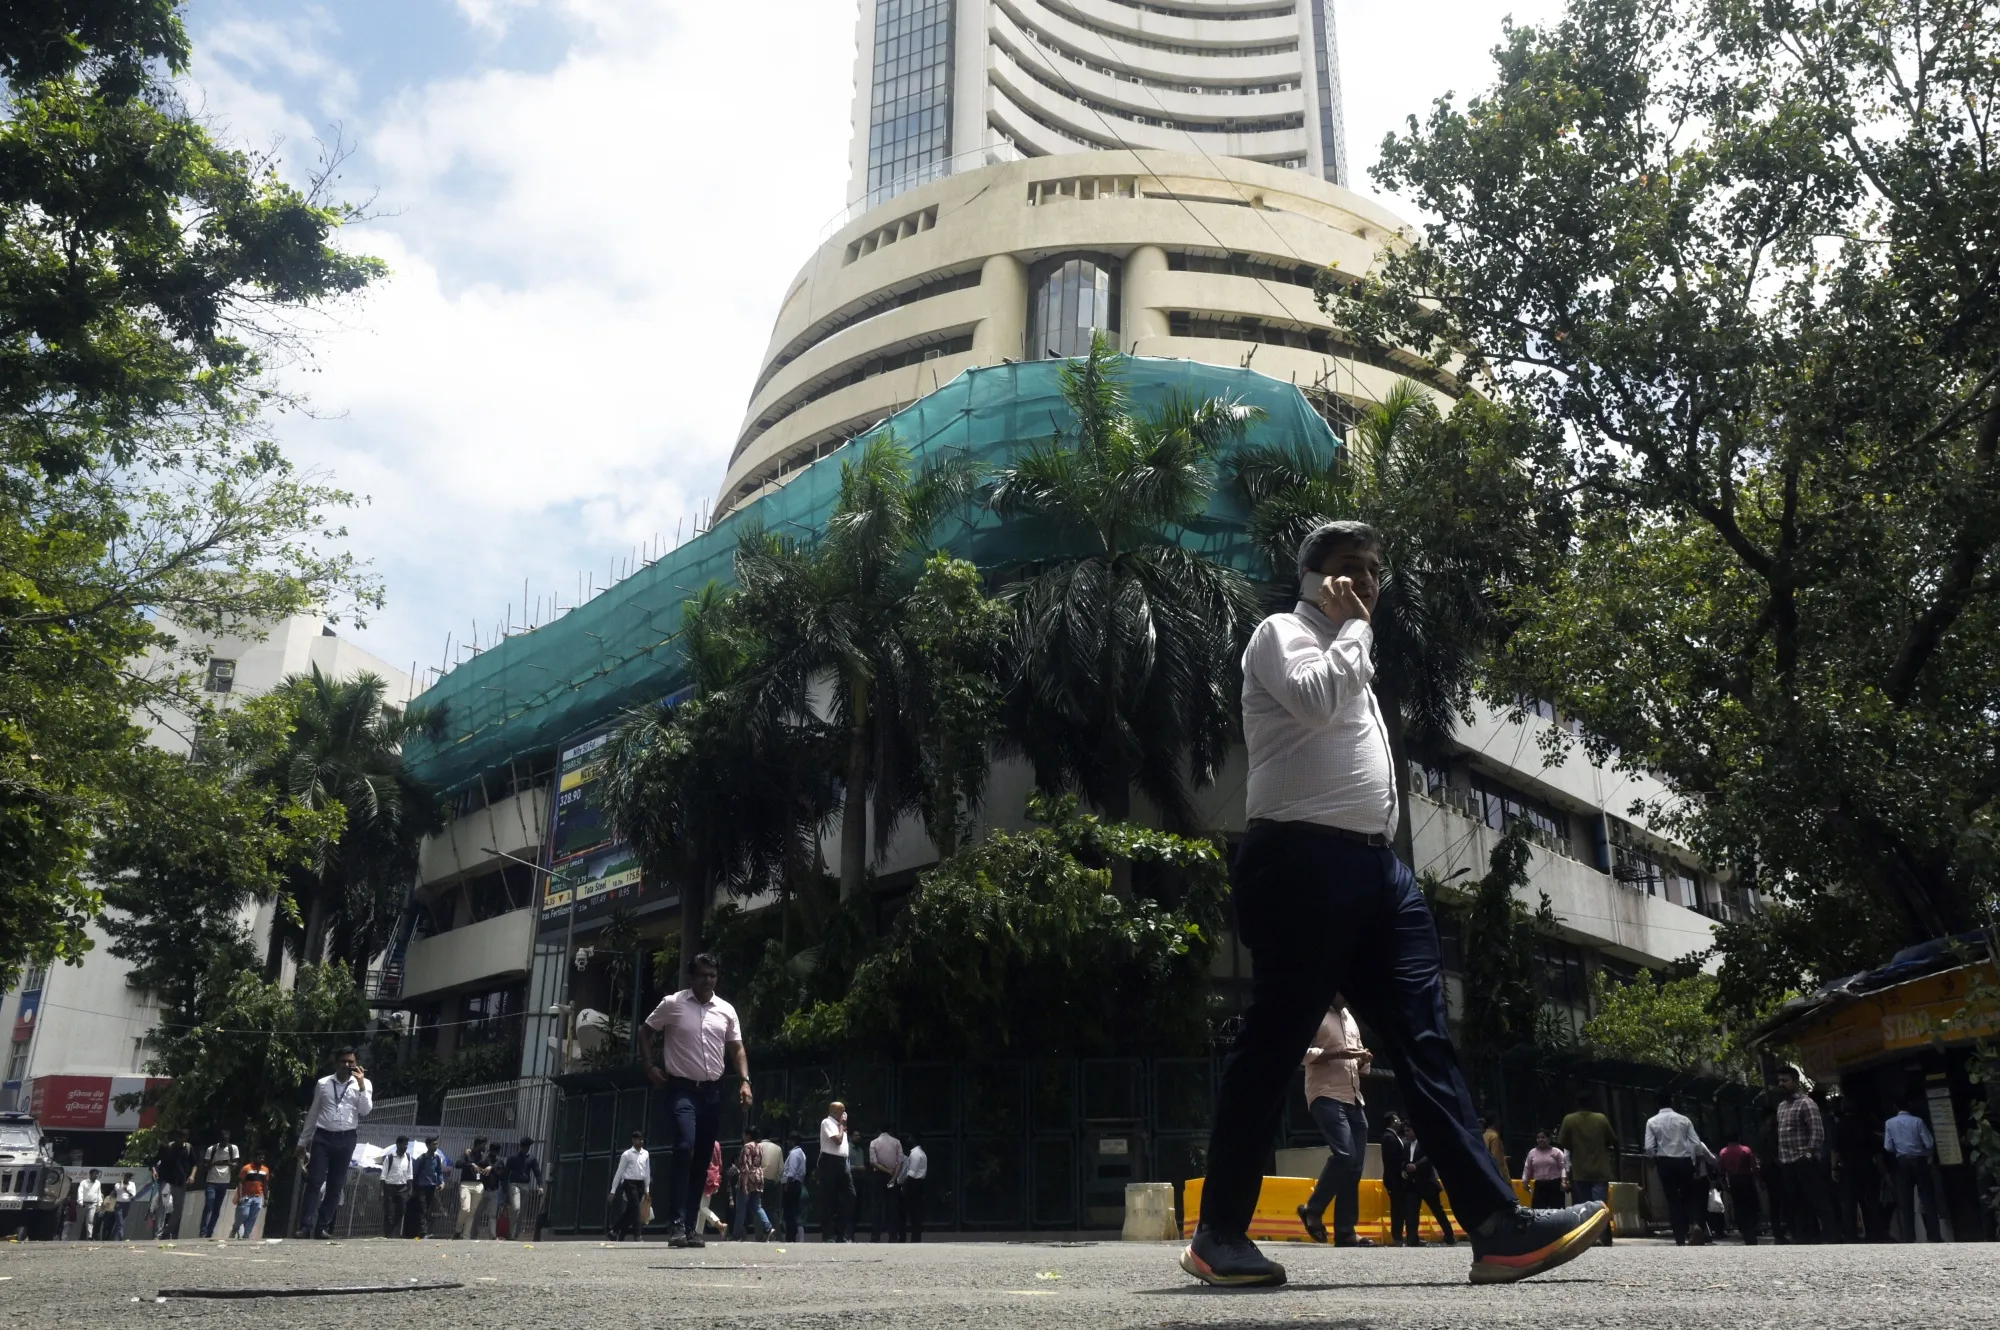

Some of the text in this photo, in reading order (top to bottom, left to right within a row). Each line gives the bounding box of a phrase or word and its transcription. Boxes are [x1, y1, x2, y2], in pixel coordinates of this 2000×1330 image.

[559, 788, 582, 807] 328.90
[570, 858, 584, 868] UPDATE
[584, 885, 594, 895] Tata
[595, 879, 607, 892] Steel
